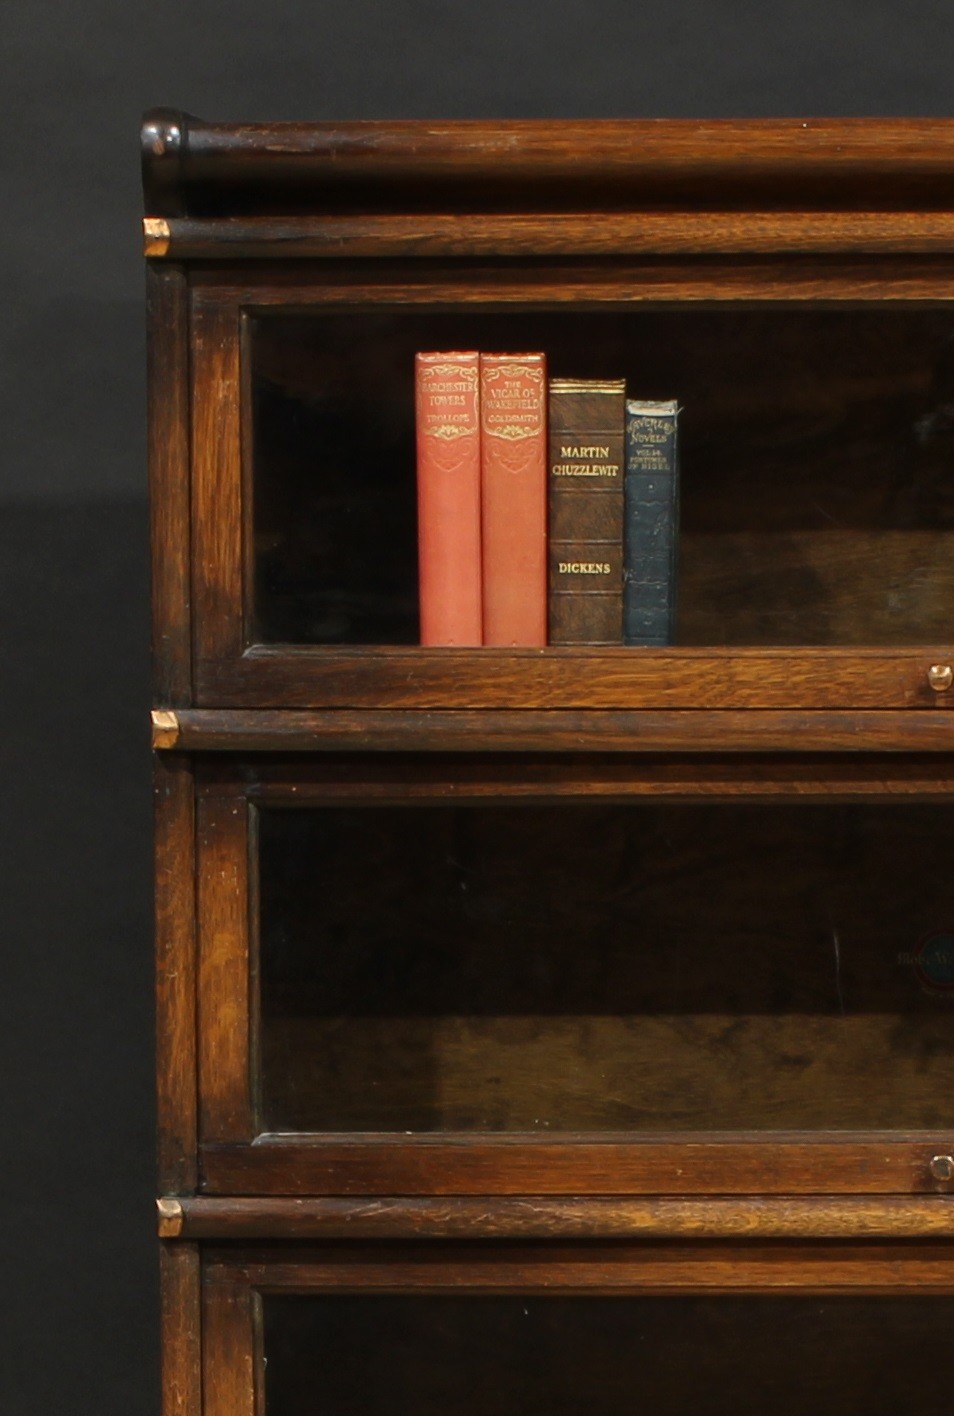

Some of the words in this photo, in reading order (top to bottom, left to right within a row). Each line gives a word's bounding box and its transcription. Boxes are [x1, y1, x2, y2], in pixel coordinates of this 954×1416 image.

[490, 388, 520, 399] VICAR
[429, 395, 466, 406] TOWERS
[560, 446, 610, 458] MARTIN
[552, 464, 619, 477] CHUZZLEWIT
[559, 562, 611, 574] DICKENS
